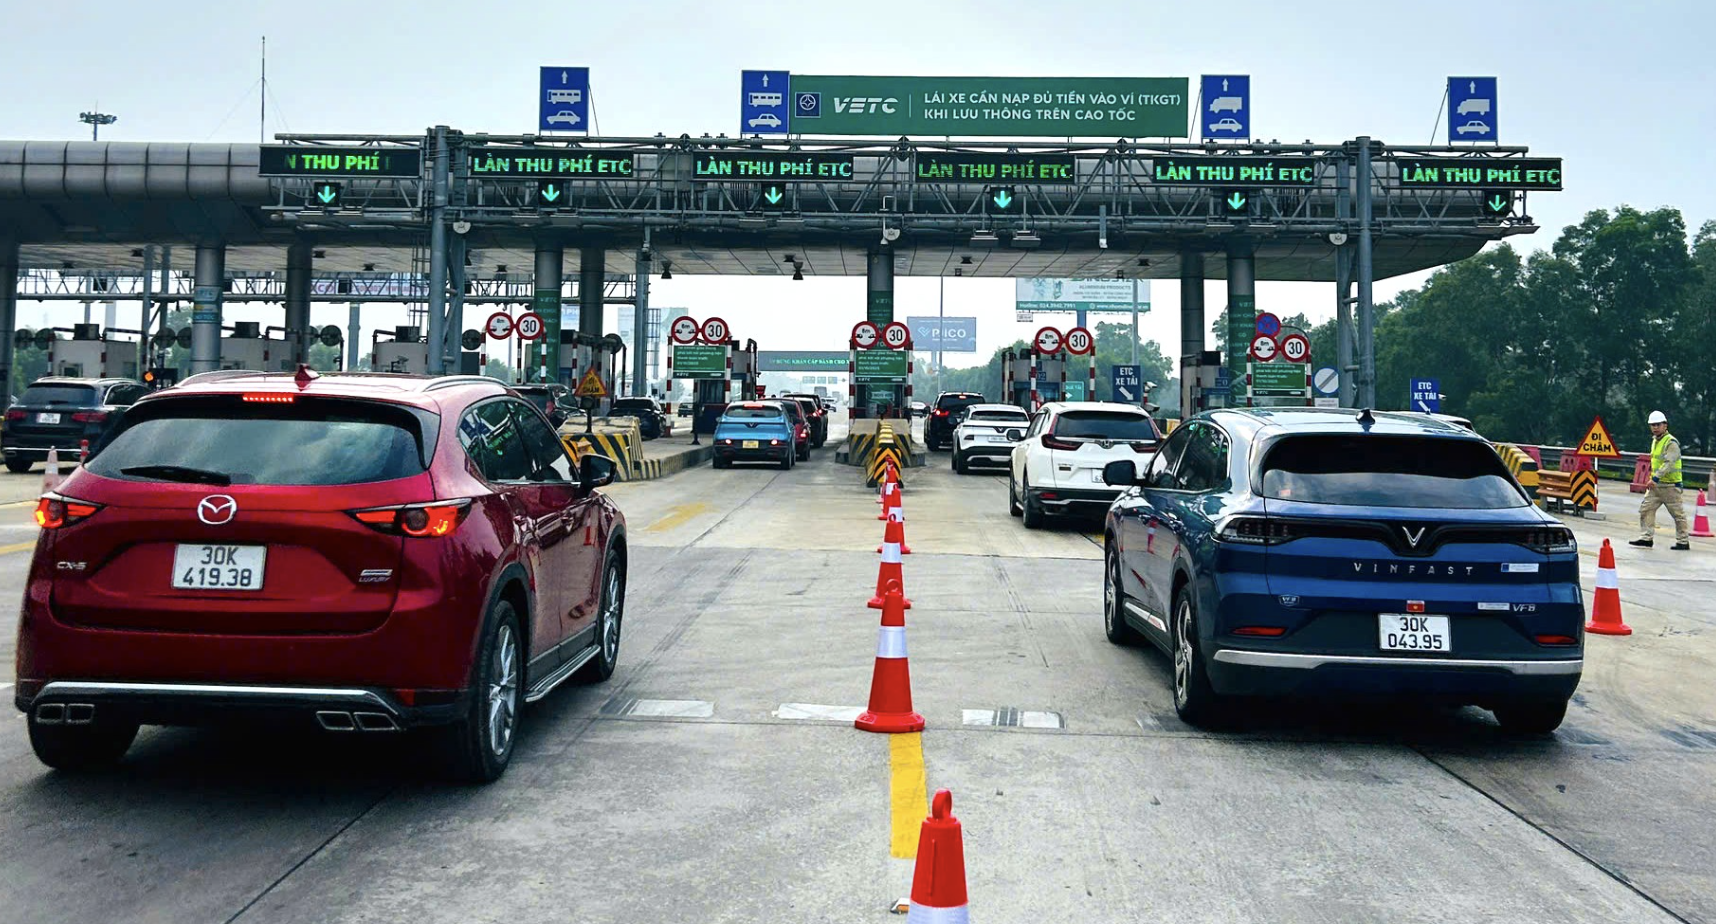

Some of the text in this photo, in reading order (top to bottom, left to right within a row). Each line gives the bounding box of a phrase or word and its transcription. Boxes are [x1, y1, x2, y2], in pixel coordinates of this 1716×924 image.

[833, 97, 899, 114] VETC
[925, 91, 947, 104] LÁI
[949, 93, 967, 104] XE
[1002, 93, 1030, 107] NẠP
[1033, 90, 1052, 105] ĐỦ
[1089, 91, 1117, 105] VÀO
[1120, 92, 1134, 105] VÍ
[1138, 94, 1181, 106] (TKGT)
[925, 106, 1136, 121] KHI LƯU THÔNG TRÊN CAO TỐC
[302, 154, 340, 170] THU
[345, 151, 380, 171] PHÍ
[473, 152, 632, 175] LÀN THU PHÍ ETC
[696, 156, 852, 177] LÀN THU PHÍ ETC
[918, 159, 1073, 179] LÀN THU PHÍ ETC
[1156, 161, 1313, 182] LÀN THU PHÍ ETC
[1403, 163, 1560, 184] LÀN THU PHÍ ETC
[522, 320, 537, 333] 30
[708, 324, 723, 338] 30
[889, 329, 903, 342] 30
[1071, 334, 1086, 348] 30
[1288, 341, 1302, 355] 30
[1119, 367, 1134, 376] ETC
[1115, 377, 1125, 386] XE
[1418, 381, 1432, 390] ETC
[1414, 392, 1423, 400] XE
[1591, 433, 1601, 441] ĐI
[1583, 442, 1611, 453] CHẬM
[201, 547, 237, 565] 30K
[183, 568, 252, 587] 419.38
[1400, 617, 1429, 633] 30K
[1388, 634, 1443, 650] 043.95
